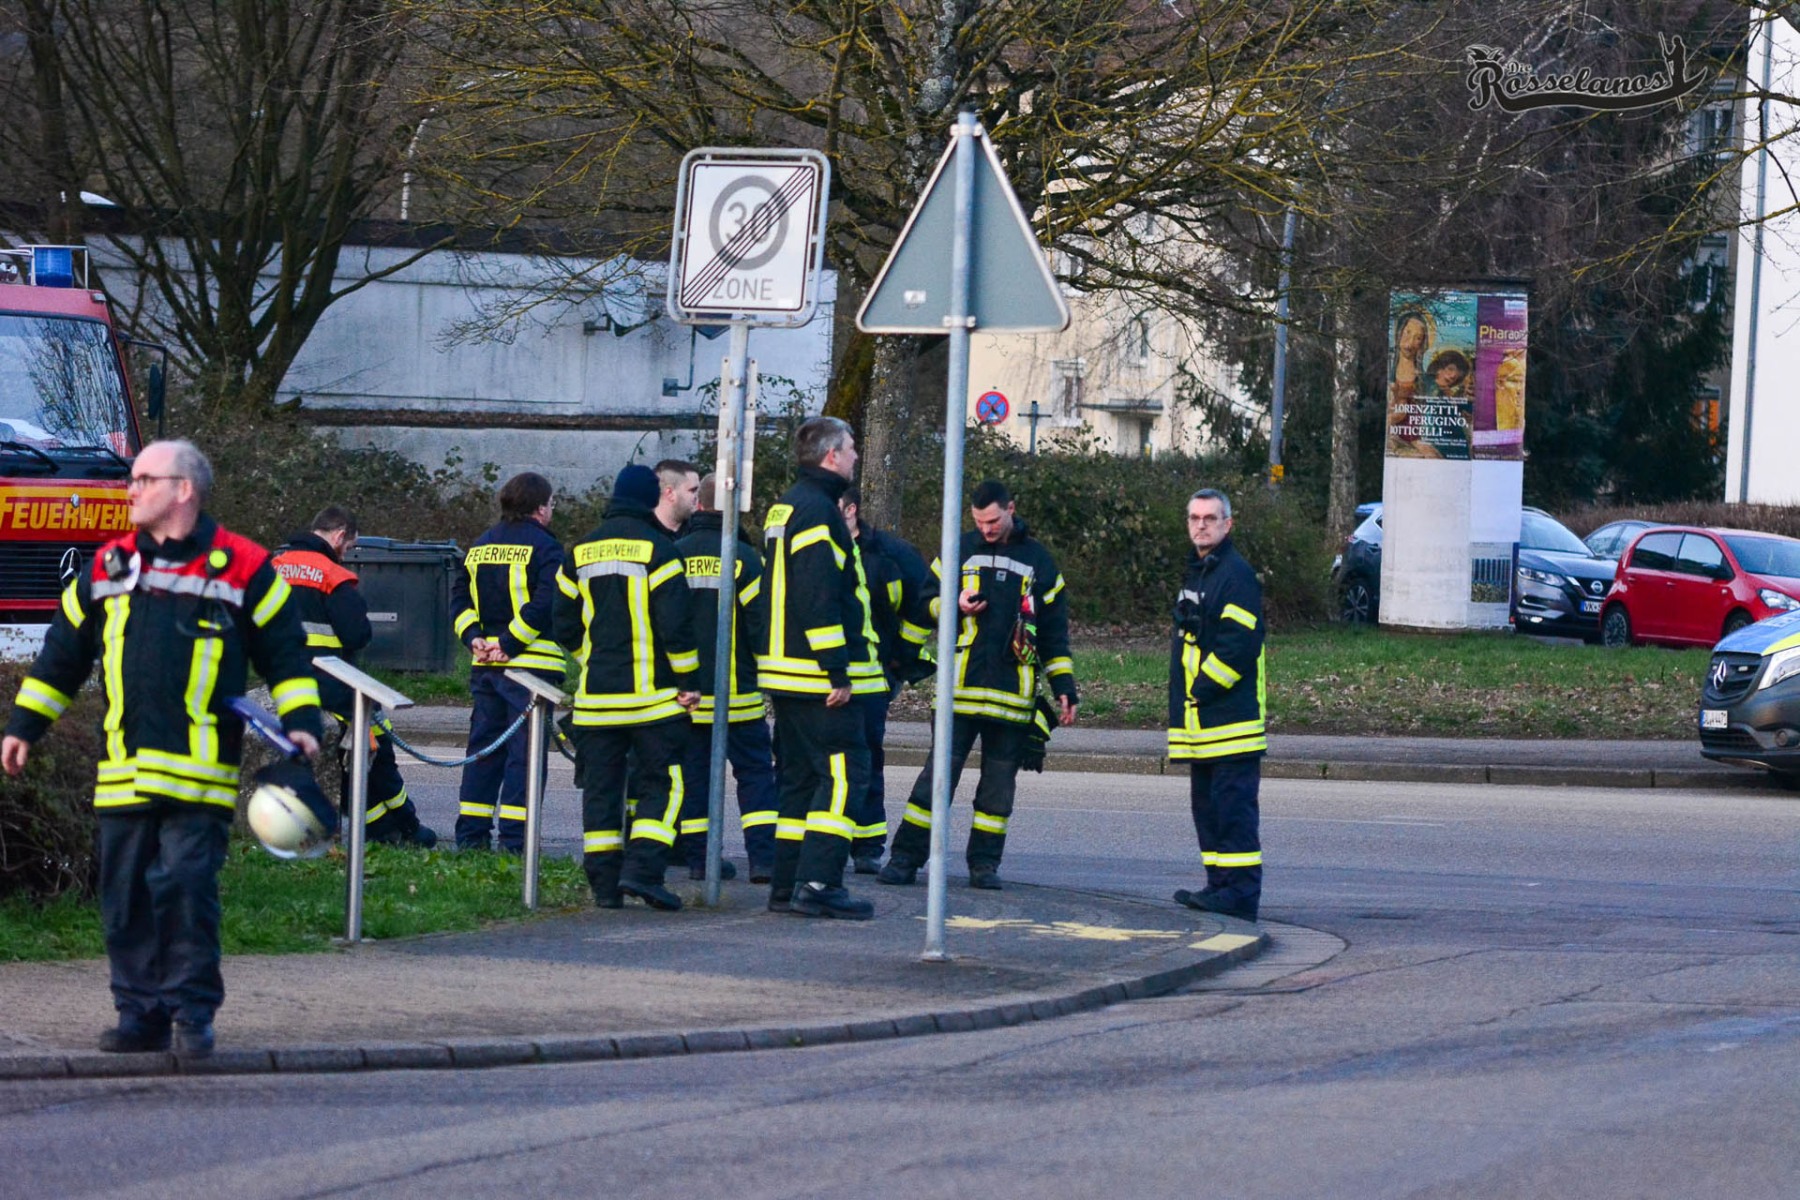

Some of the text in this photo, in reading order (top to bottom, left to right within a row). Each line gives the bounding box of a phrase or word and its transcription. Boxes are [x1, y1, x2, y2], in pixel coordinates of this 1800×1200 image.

[725, 201, 770, 244] 30
[712, 277, 774, 301] ZONE
[1409, 415, 1469, 428] PERUGINO,
[688, 559, 720, 575] ERWE
